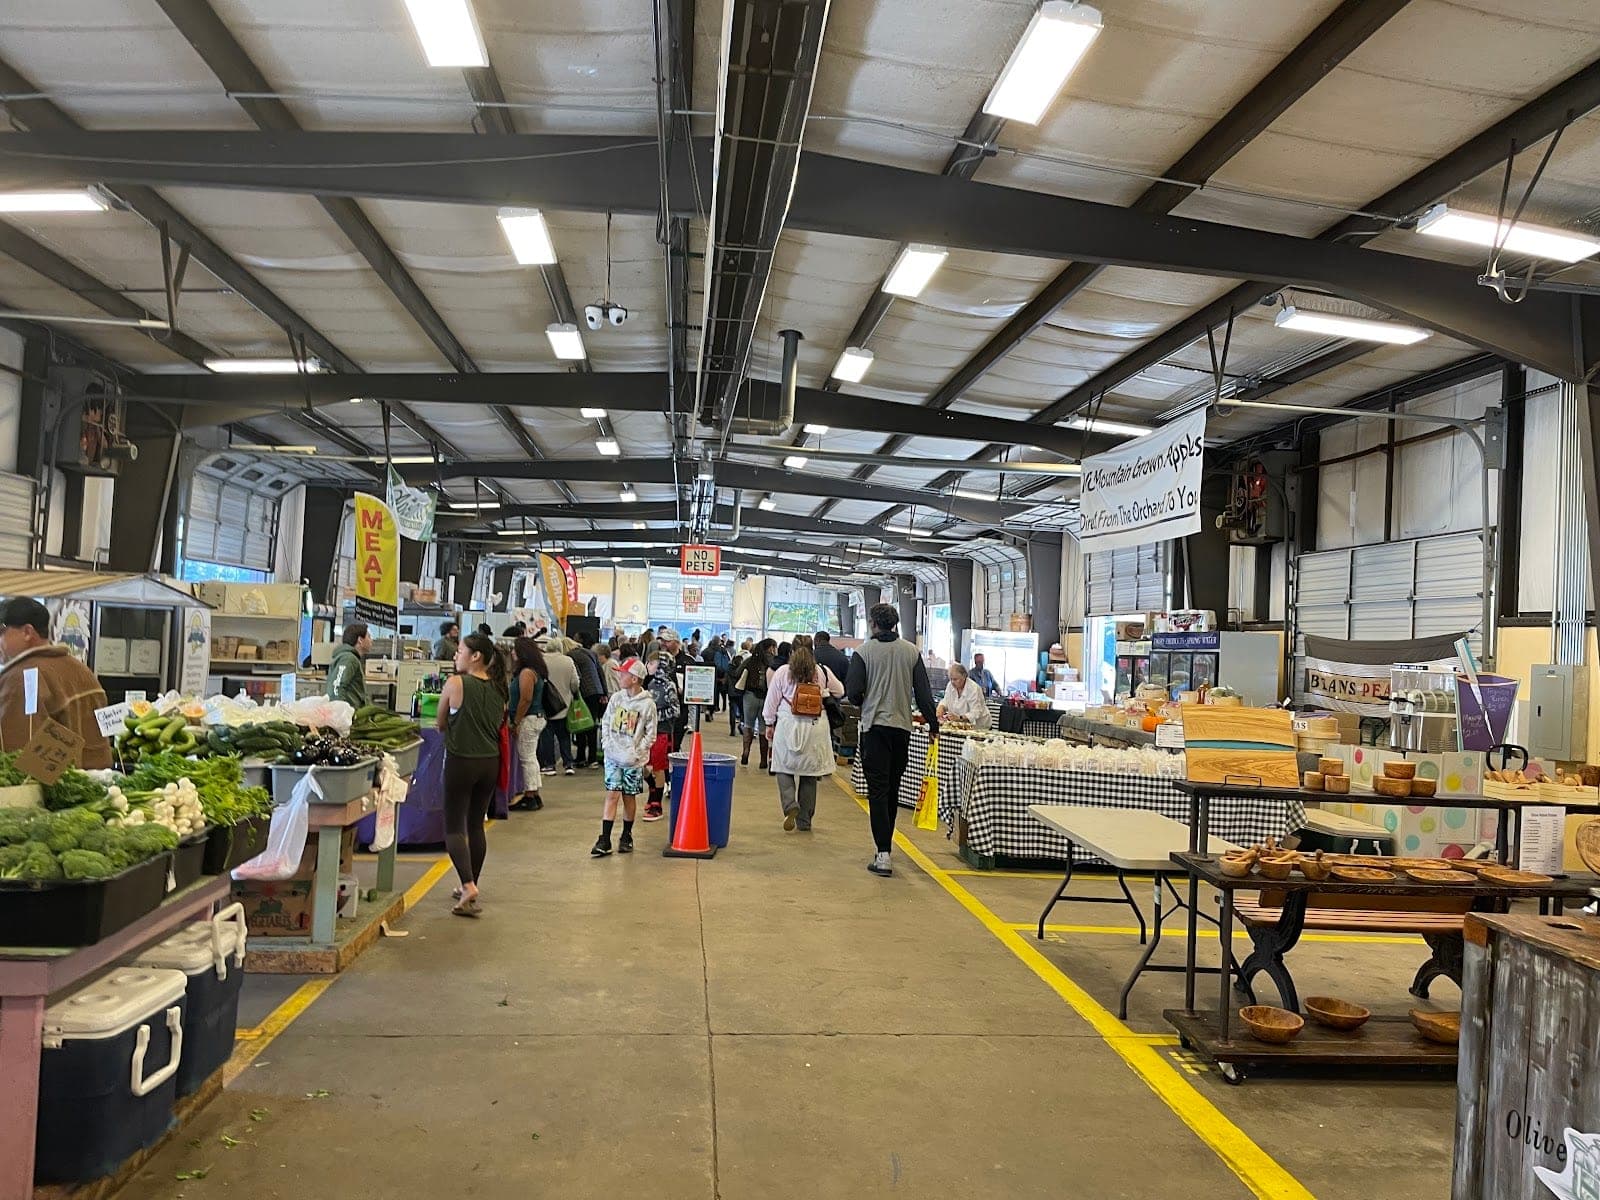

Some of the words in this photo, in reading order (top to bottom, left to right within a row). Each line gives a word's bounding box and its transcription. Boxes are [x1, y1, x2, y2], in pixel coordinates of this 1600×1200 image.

[1094, 463, 1132, 489] Mountain
[1132, 455, 1163, 479] Grown
[1098, 509, 1119, 528] From
[1118, 505, 1131, 525] The
[361, 509, 383, 597] MEAT
[686, 561, 714, 571] PETS
[693, 550, 708, 560] NO
[1506, 1109, 1567, 1162] Olive
